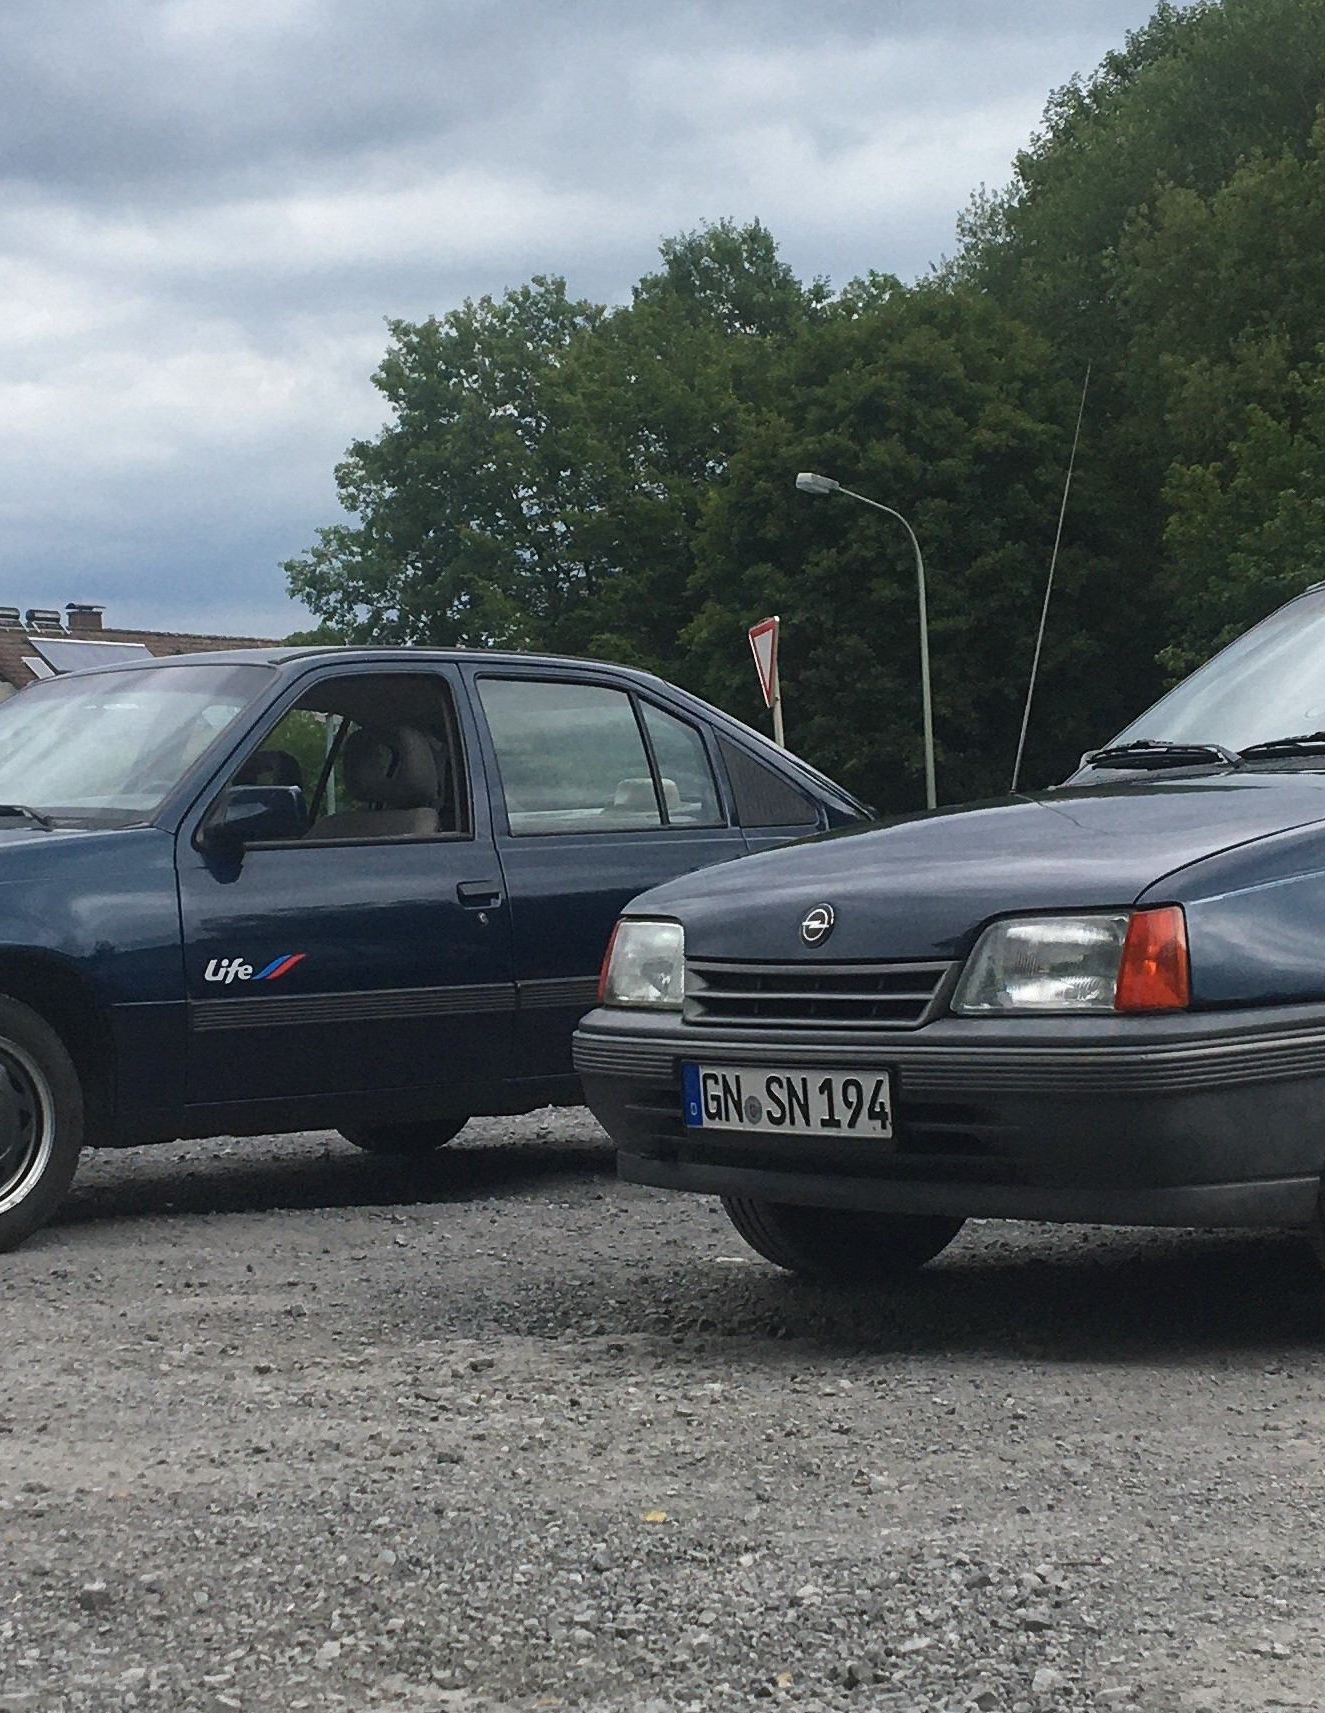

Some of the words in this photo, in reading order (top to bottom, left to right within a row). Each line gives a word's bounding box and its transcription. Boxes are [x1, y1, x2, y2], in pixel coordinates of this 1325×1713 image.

[204, 957, 253, 984] Life
[702, 1072, 744, 1123] GN
[765, 1074, 811, 1126] SN
[818, 1077, 889, 1130] 194
